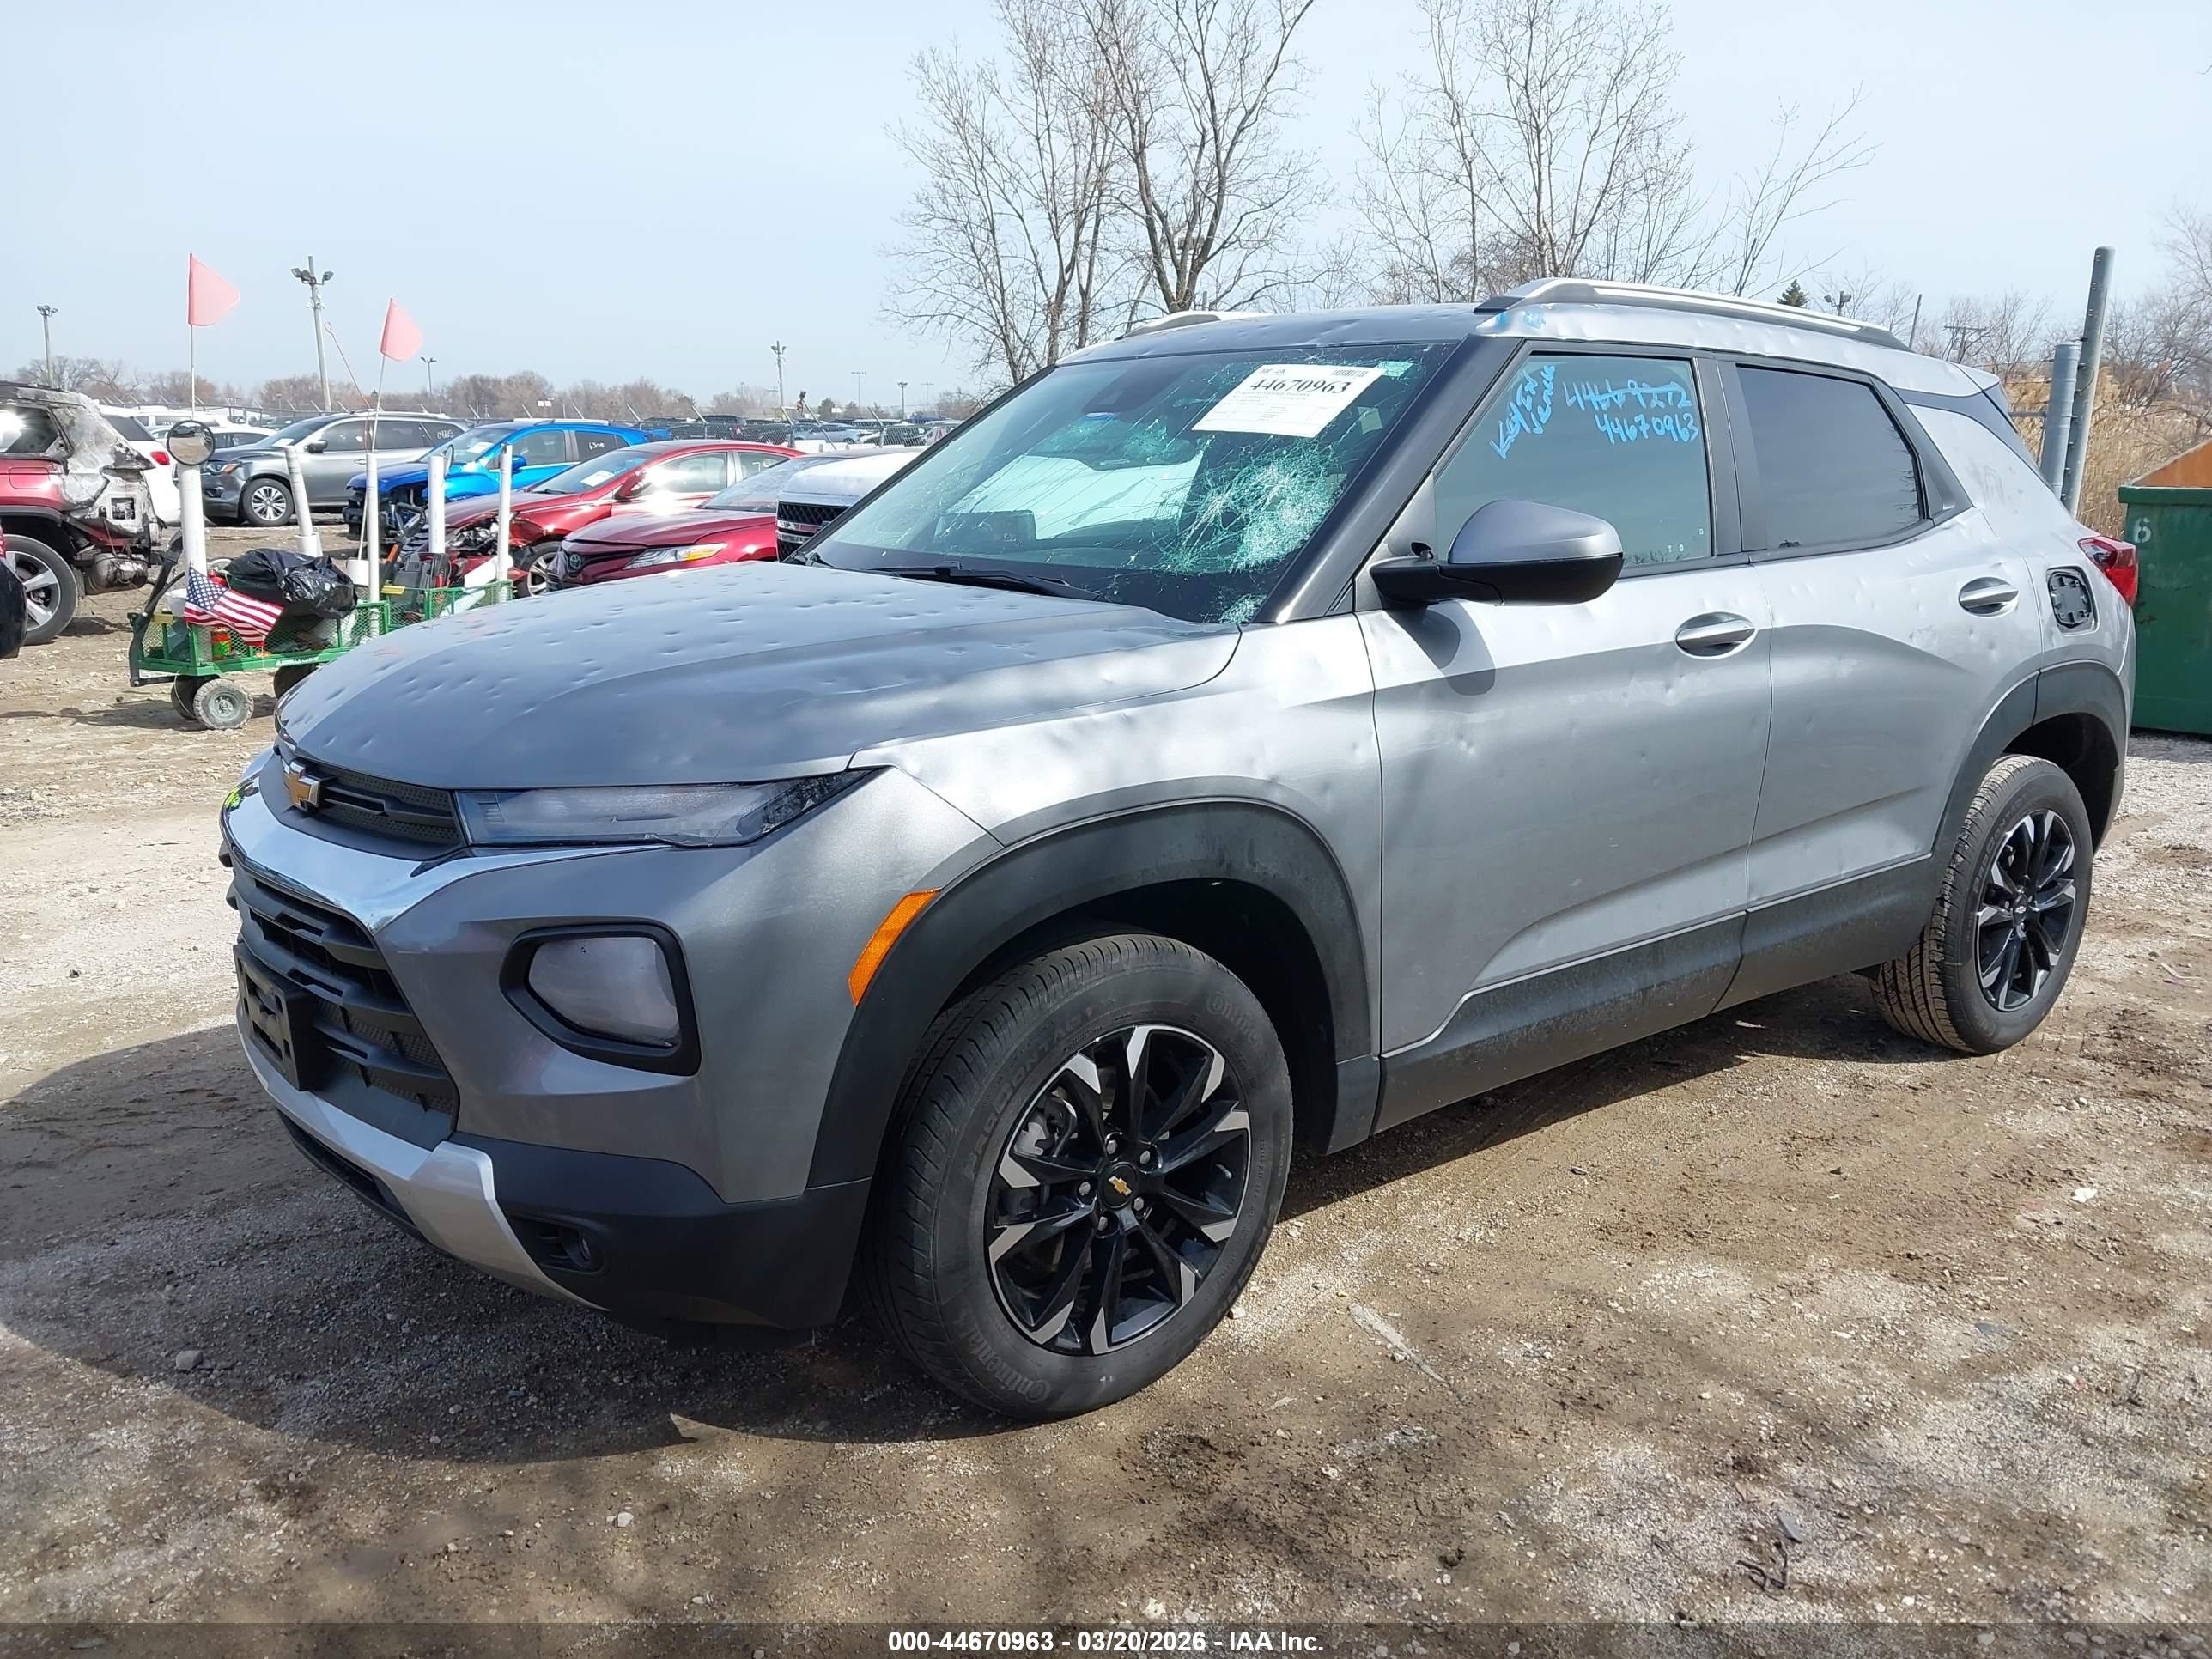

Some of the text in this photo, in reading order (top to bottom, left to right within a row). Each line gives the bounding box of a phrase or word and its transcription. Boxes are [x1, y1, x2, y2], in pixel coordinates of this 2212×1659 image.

[1250, 378, 1352, 394] 44670963
[1594, 412, 1699, 445] 44670963
[2134, 517, 2151, 544] 6
